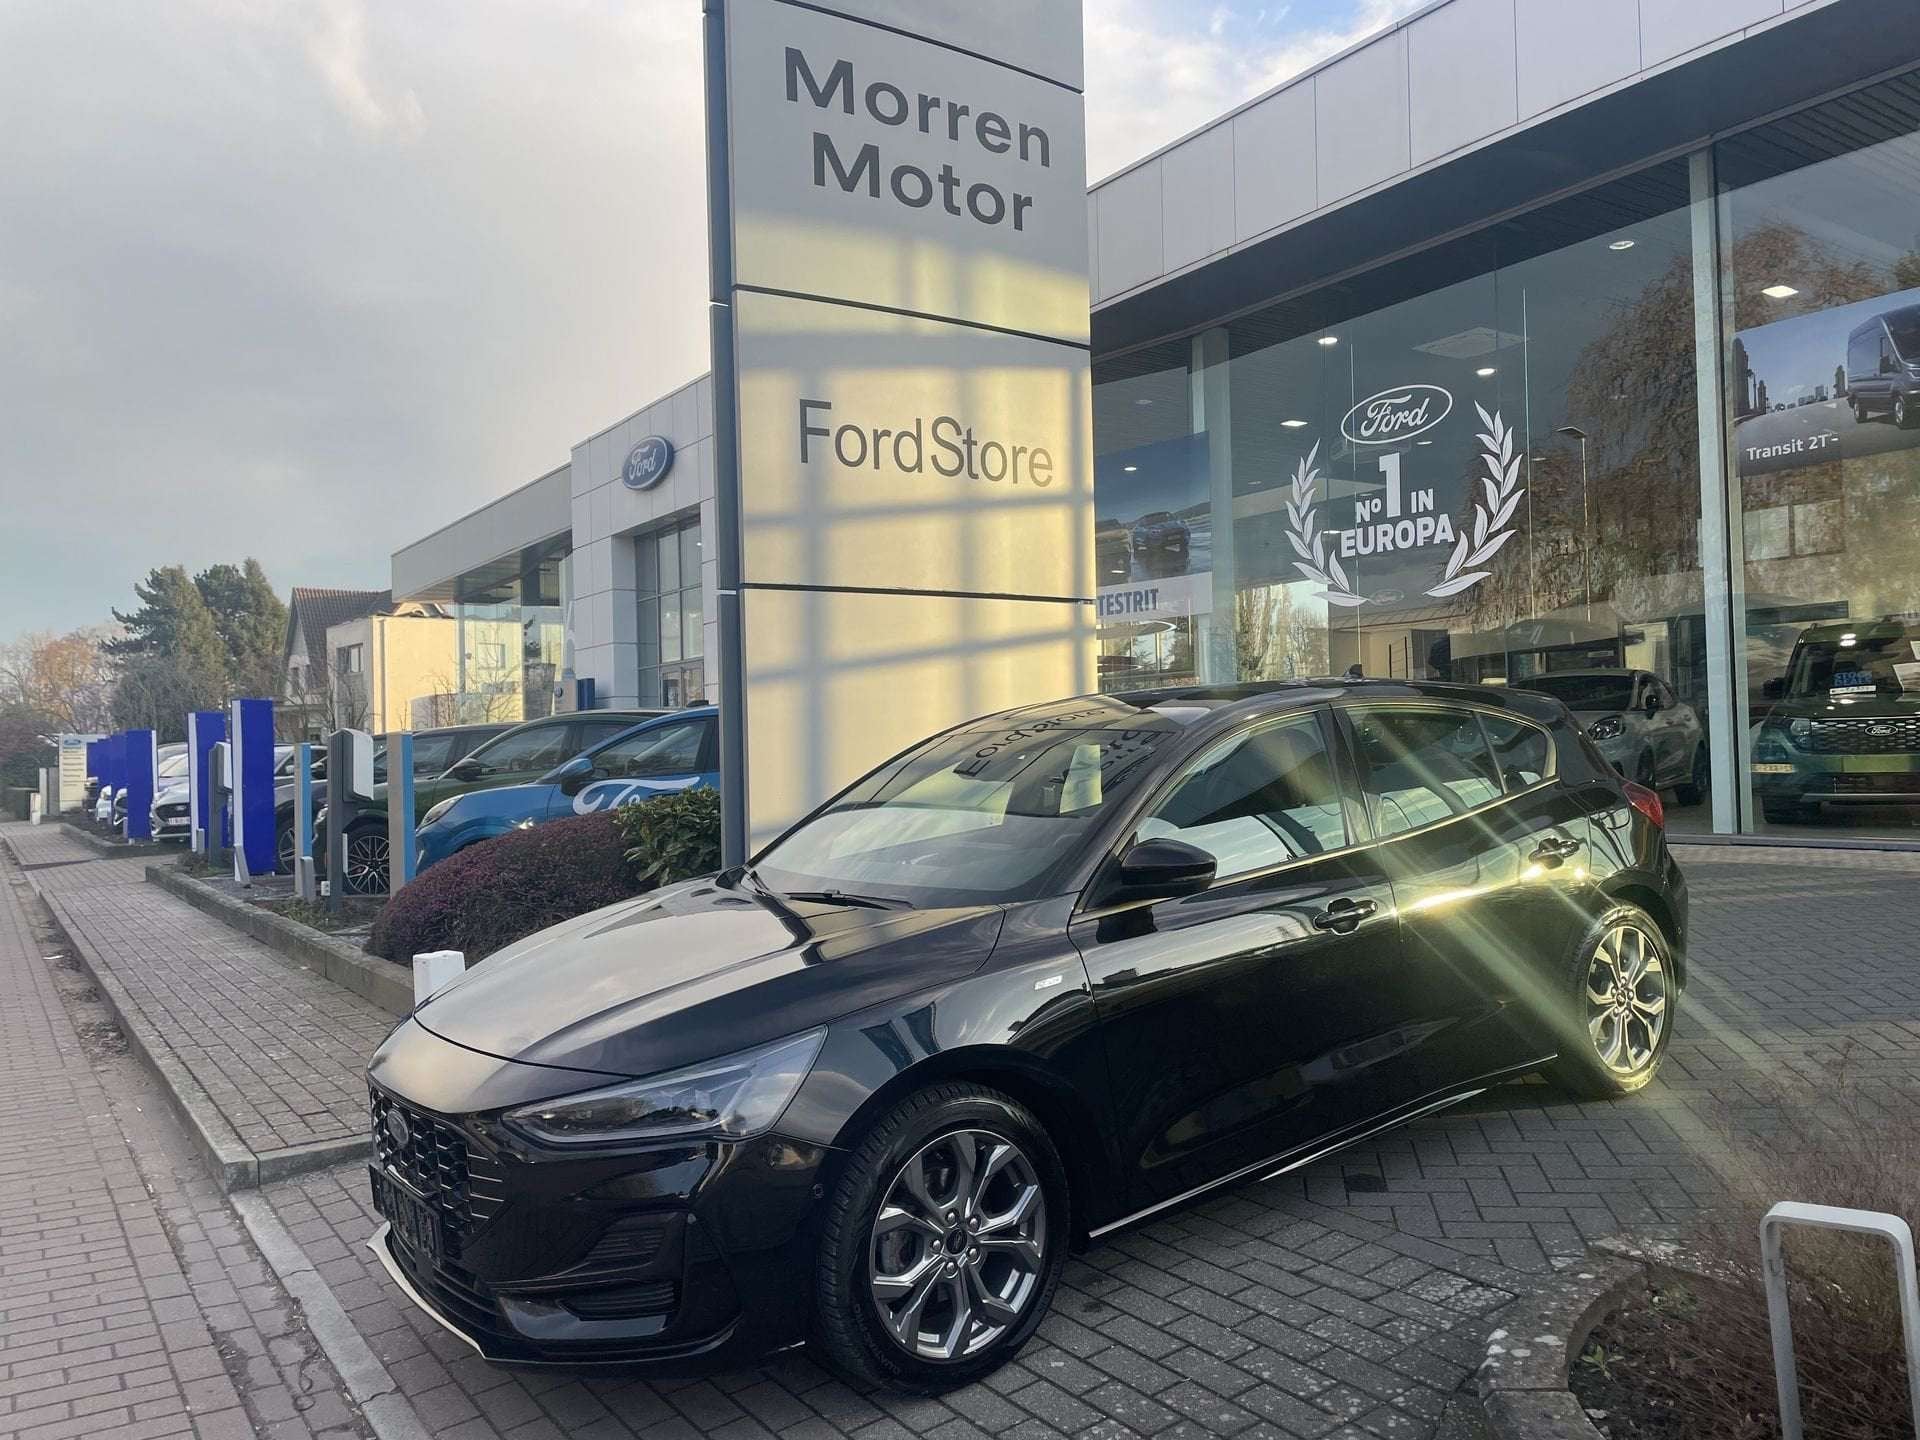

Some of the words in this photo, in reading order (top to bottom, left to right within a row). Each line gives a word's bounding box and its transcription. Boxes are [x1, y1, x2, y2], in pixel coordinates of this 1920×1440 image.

[785, 46, 1050, 168] Morren
[813, 132, 1033, 231] Motor
[1361, 394, 1431, 437] Ford
[799, 398, 1053, 487] FordStore
[1746, 438, 1804, 460] Transit
[1411, 488, 1434, 514] IN
[1341, 513, 1456, 558] EUROPA
[1097, 588, 1159, 616] TESTRIT
